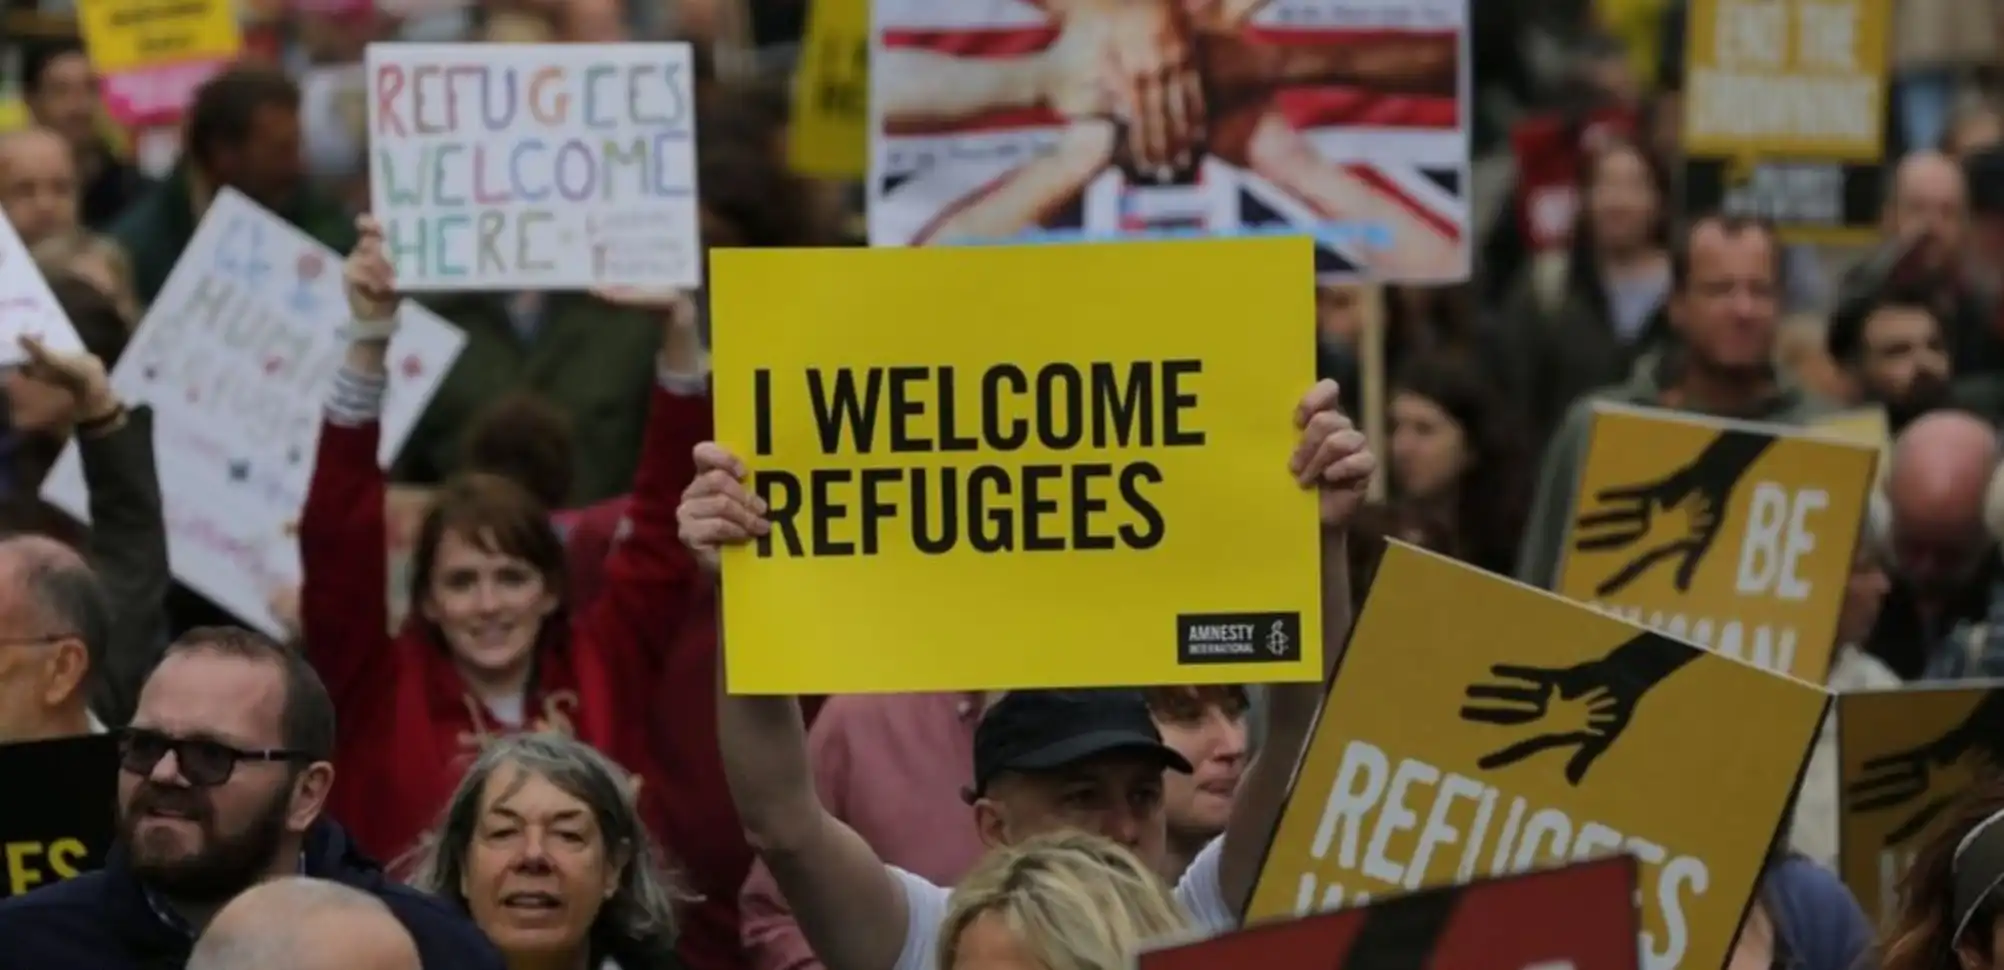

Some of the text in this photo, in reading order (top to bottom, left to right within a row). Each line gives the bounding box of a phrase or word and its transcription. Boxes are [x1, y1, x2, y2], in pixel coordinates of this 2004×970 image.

[377, 62, 687, 137] REFUGEES
[379, 131, 695, 207] WELCOME
[754, 359, 1207, 456] I WELCOME
[754, 461, 1166, 558] REFUGEES
[1736, 480, 1830, 599] BE
[1188, 623, 1255, 642] AMNESTY
